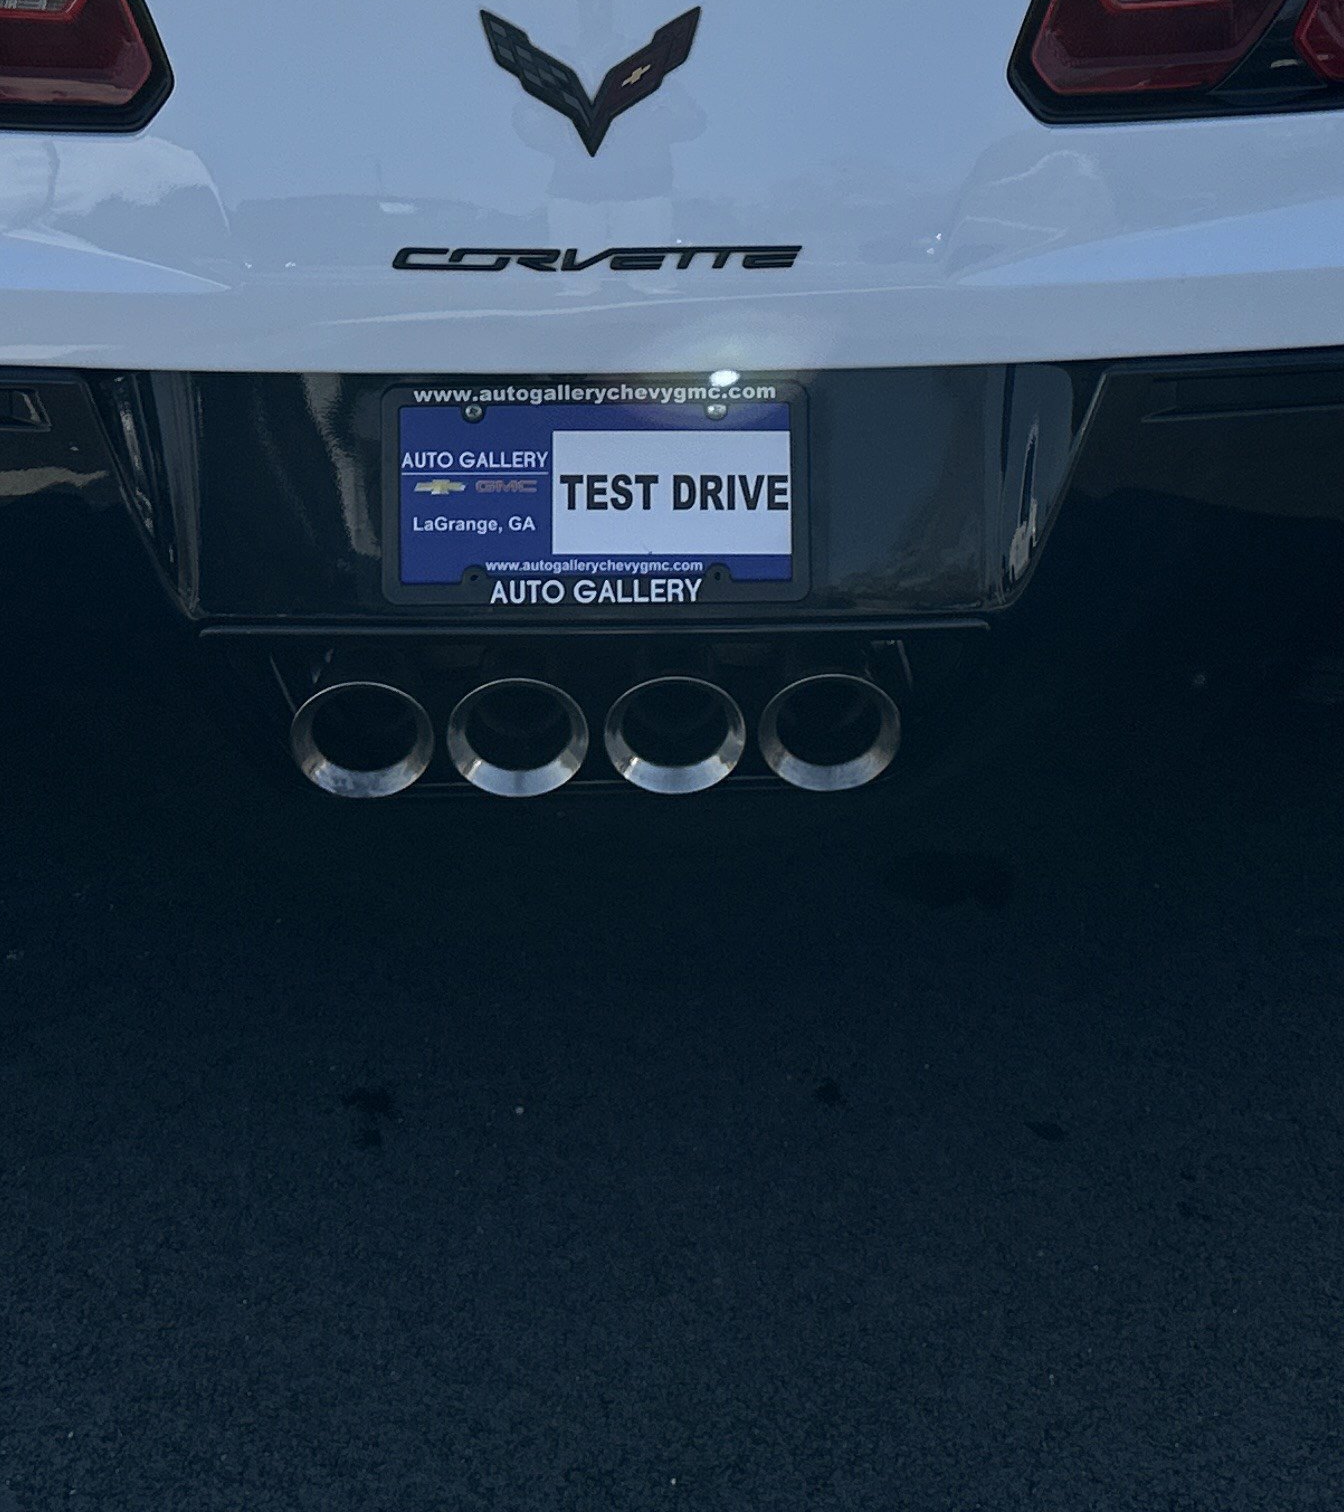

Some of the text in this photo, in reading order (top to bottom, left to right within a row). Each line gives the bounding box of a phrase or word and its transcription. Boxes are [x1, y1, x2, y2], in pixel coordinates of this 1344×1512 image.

[392, 245, 802, 272] CORVETTE
[413, 384, 776, 405] www.autogallerychevygmc.com
[401, 451, 549, 469] AUTO GALLERY
[475, 479, 538, 493] GMC
[560, 474, 789, 511] TEST DRIVE
[413, 516, 536, 534] LaGrange, GA
[485, 559, 703, 574] www.autogallerychevygmc.com
[490, 578, 702, 604] AUTO GALLERY
